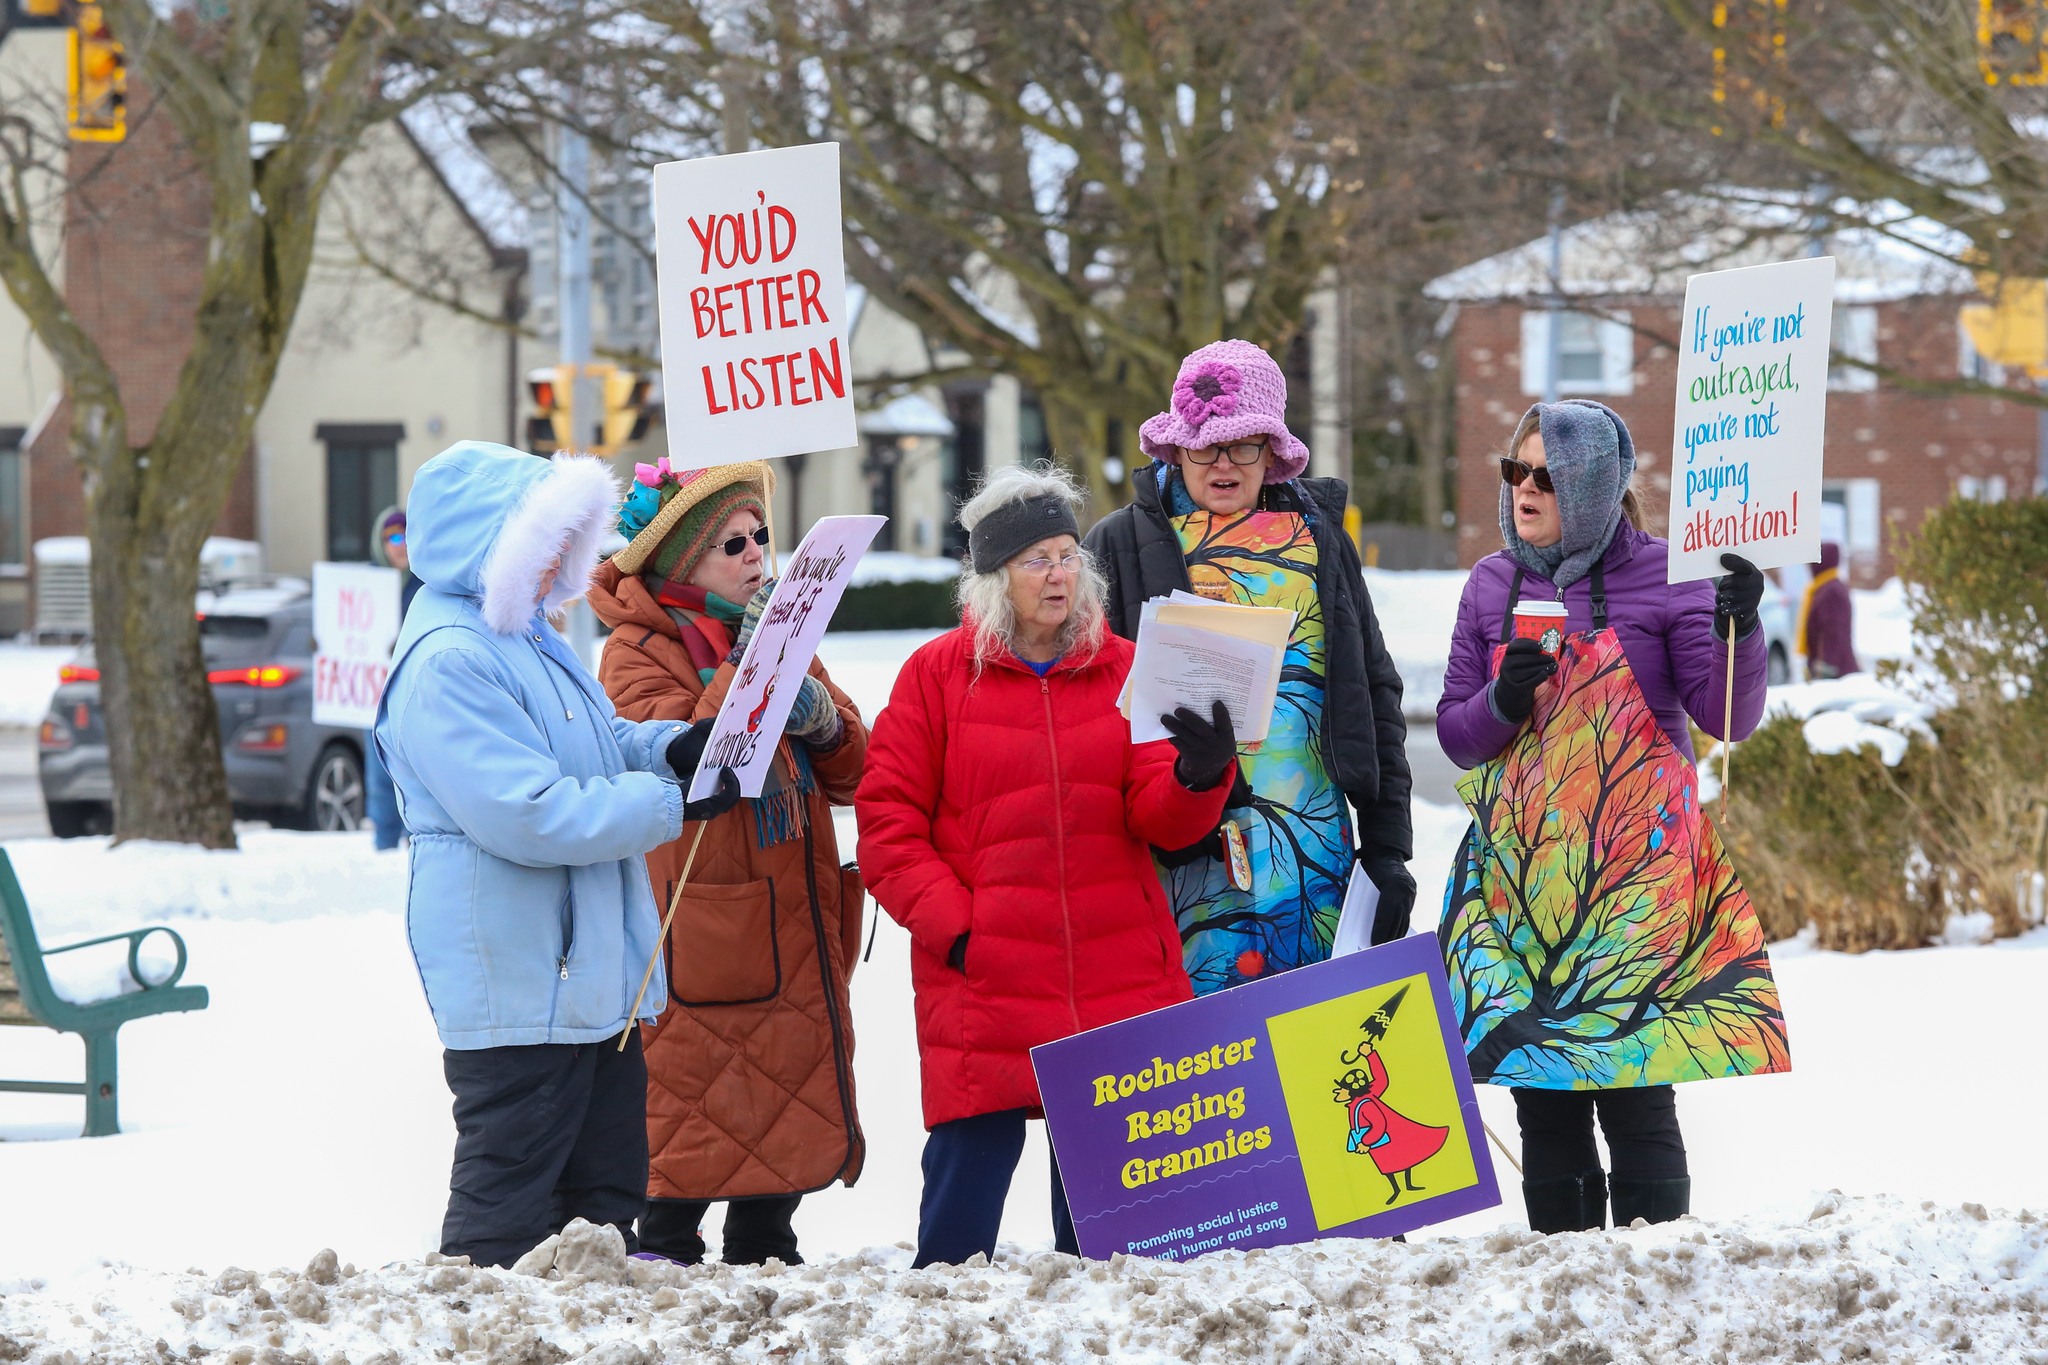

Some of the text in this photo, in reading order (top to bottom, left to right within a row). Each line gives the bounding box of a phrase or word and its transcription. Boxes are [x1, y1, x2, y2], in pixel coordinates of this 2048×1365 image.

[687, 190, 797, 274] YOU'D
[690, 269, 829, 339] BETTER
[1694, 302, 1805, 362] If you're not
[702, 337, 845, 415] LISTEN
[1690, 353, 1799, 405] outraged,
[1685, 402, 1779, 464] you're not
[1686, 456, 1749, 507] paying
[1683, 490, 1798, 553] attention!
[338, 587, 375, 632] NO
[316, 656, 389, 706] FASCIS
[737, 647, 760, 690] the
[1093, 1036, 1257, 1107] Rochester
[1126, 1087, 1246, 1143] Raging
[1121, 1126, 1272, 1190] Grannies
[1127, 1201, 1279, 1254] Promoting social justice
[1182, 1234, 1223, 1256] humor
[1228, 1225, 1253, 1242] and
[1256, 1216, 1288, 1233] song
